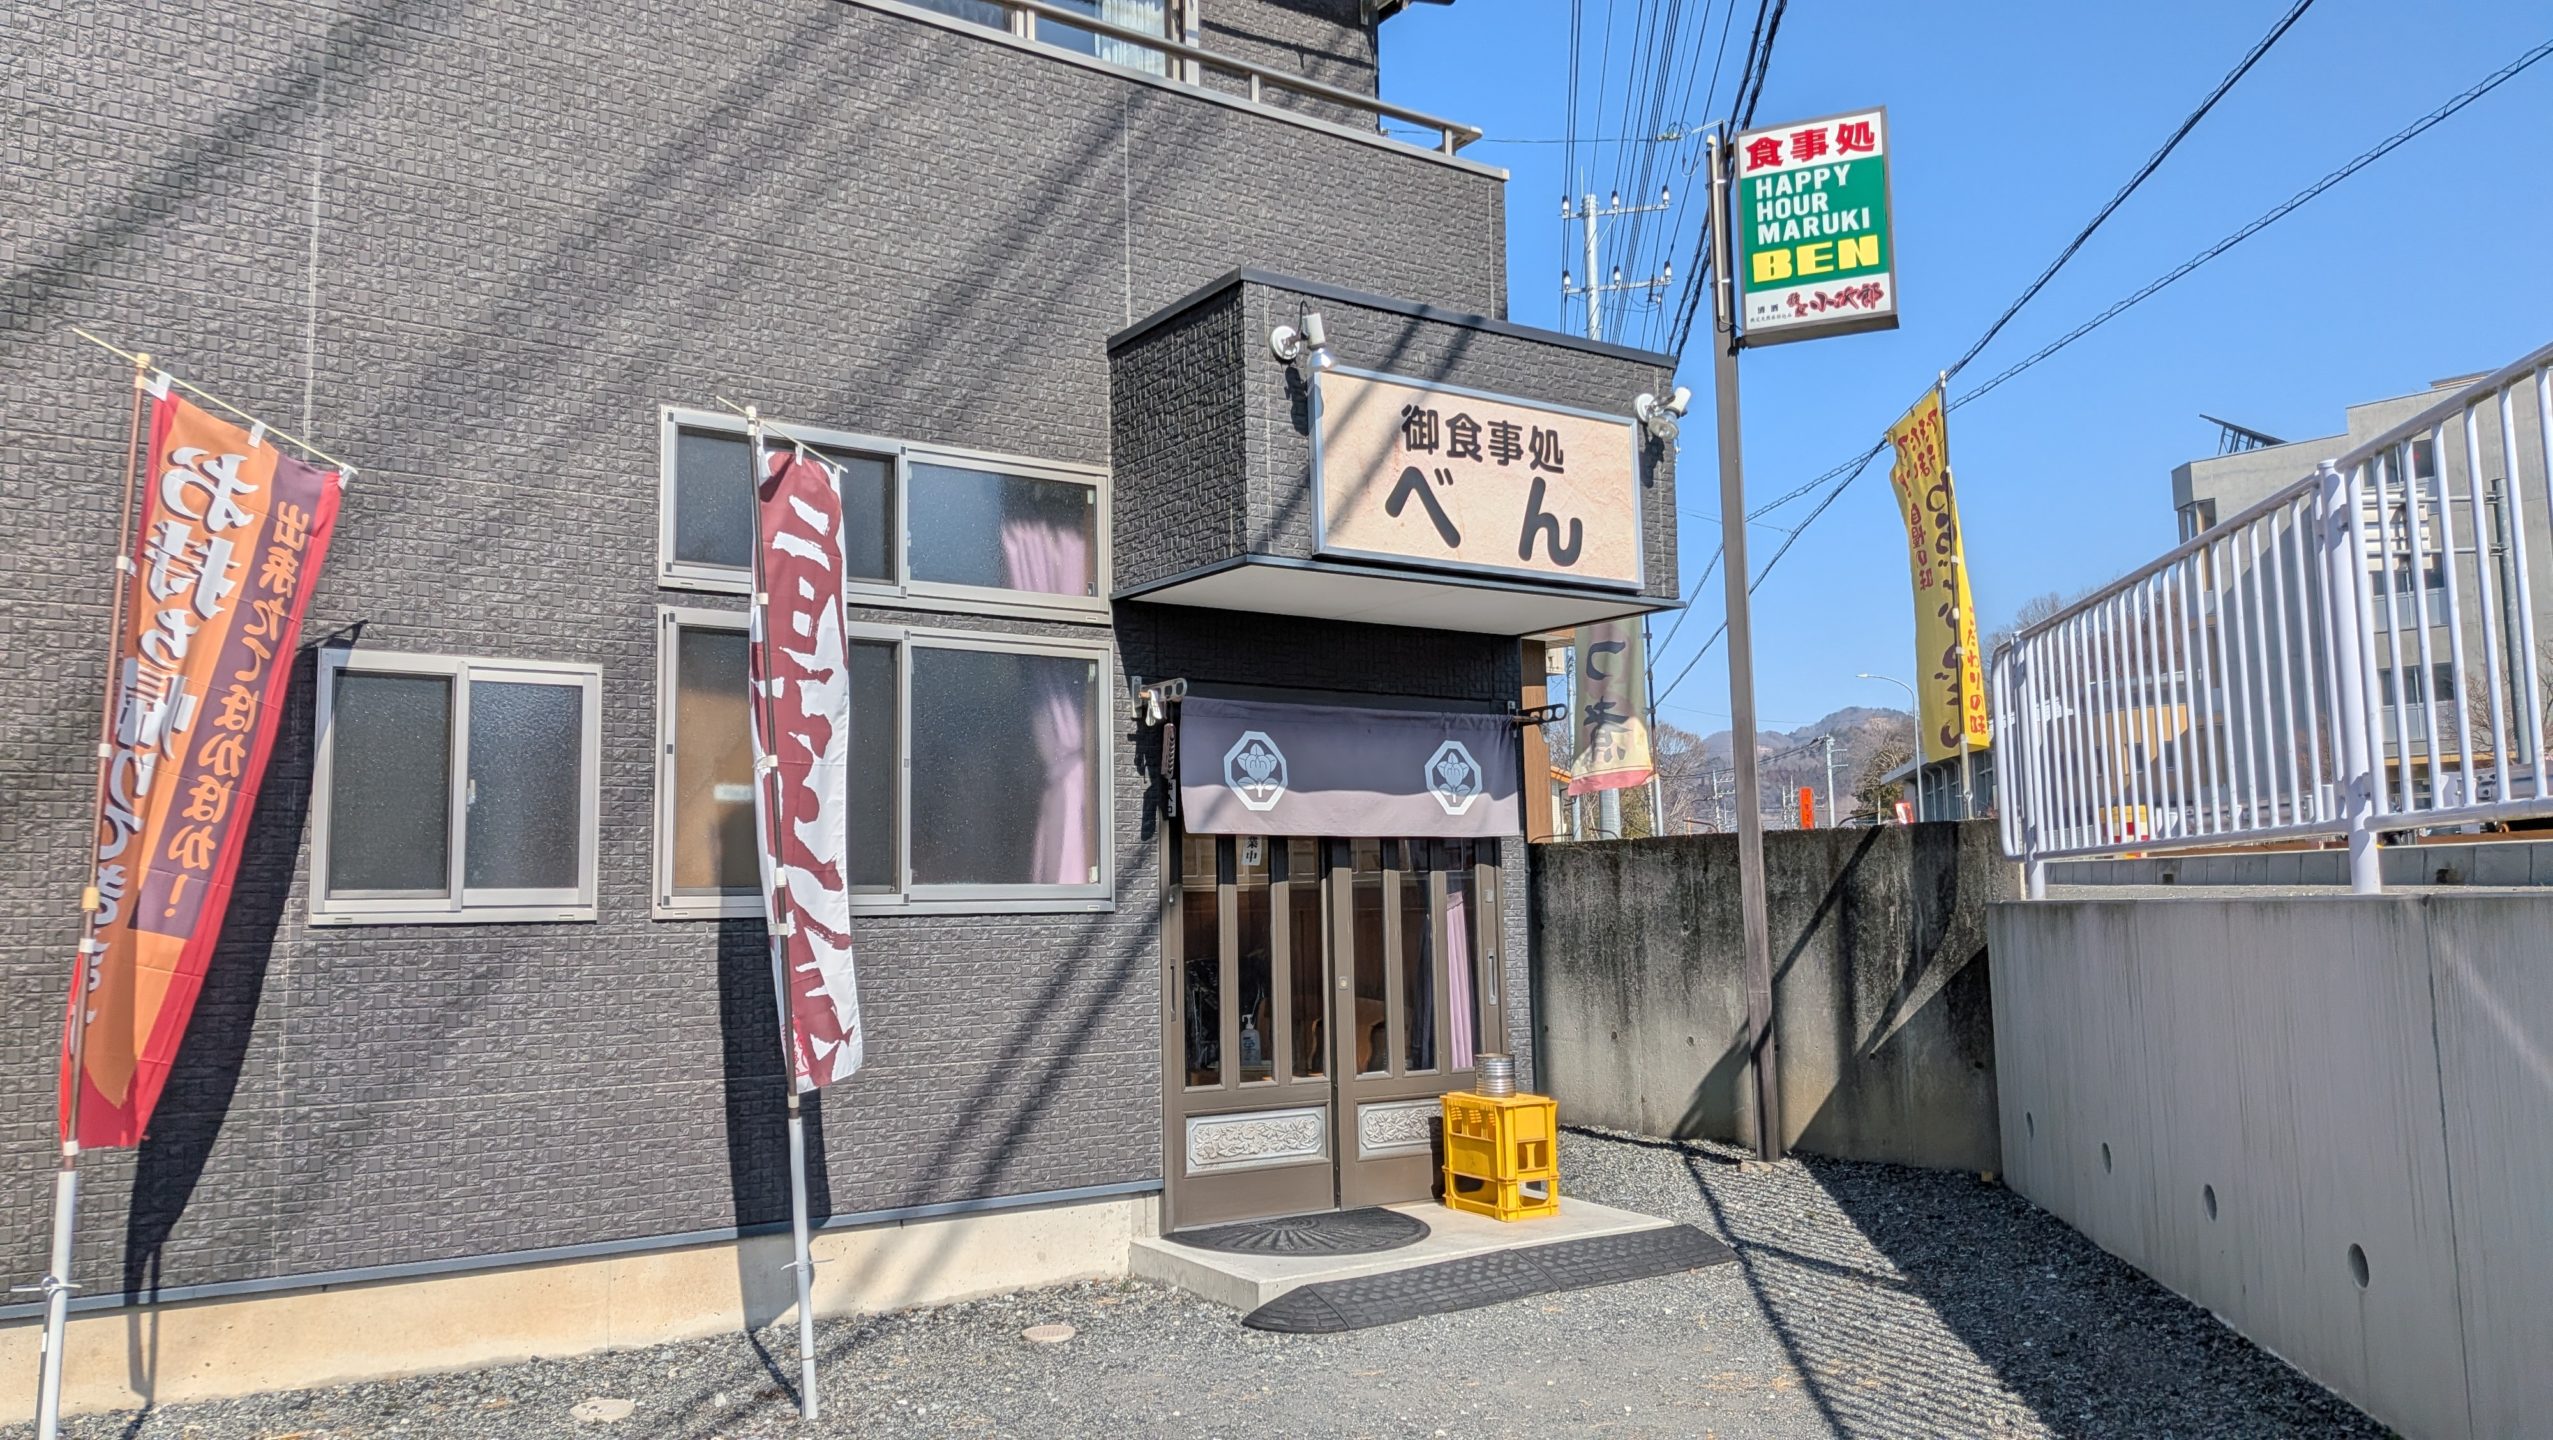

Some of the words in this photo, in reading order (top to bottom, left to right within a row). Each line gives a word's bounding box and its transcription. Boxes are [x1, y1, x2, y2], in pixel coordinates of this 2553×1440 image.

[1745, 120, 1875, 172] 食事処
[1755, 164, 1851, 200] HAPPY
[1756, 192, 1829, 222] HOUR
[1757, 207, 1871, 246] MARUKI
[1752, 234, 1880, 284] BEN
[1401, 404, 1564, 475] 御食事処
[1384, 465, 1583, 567] べん
